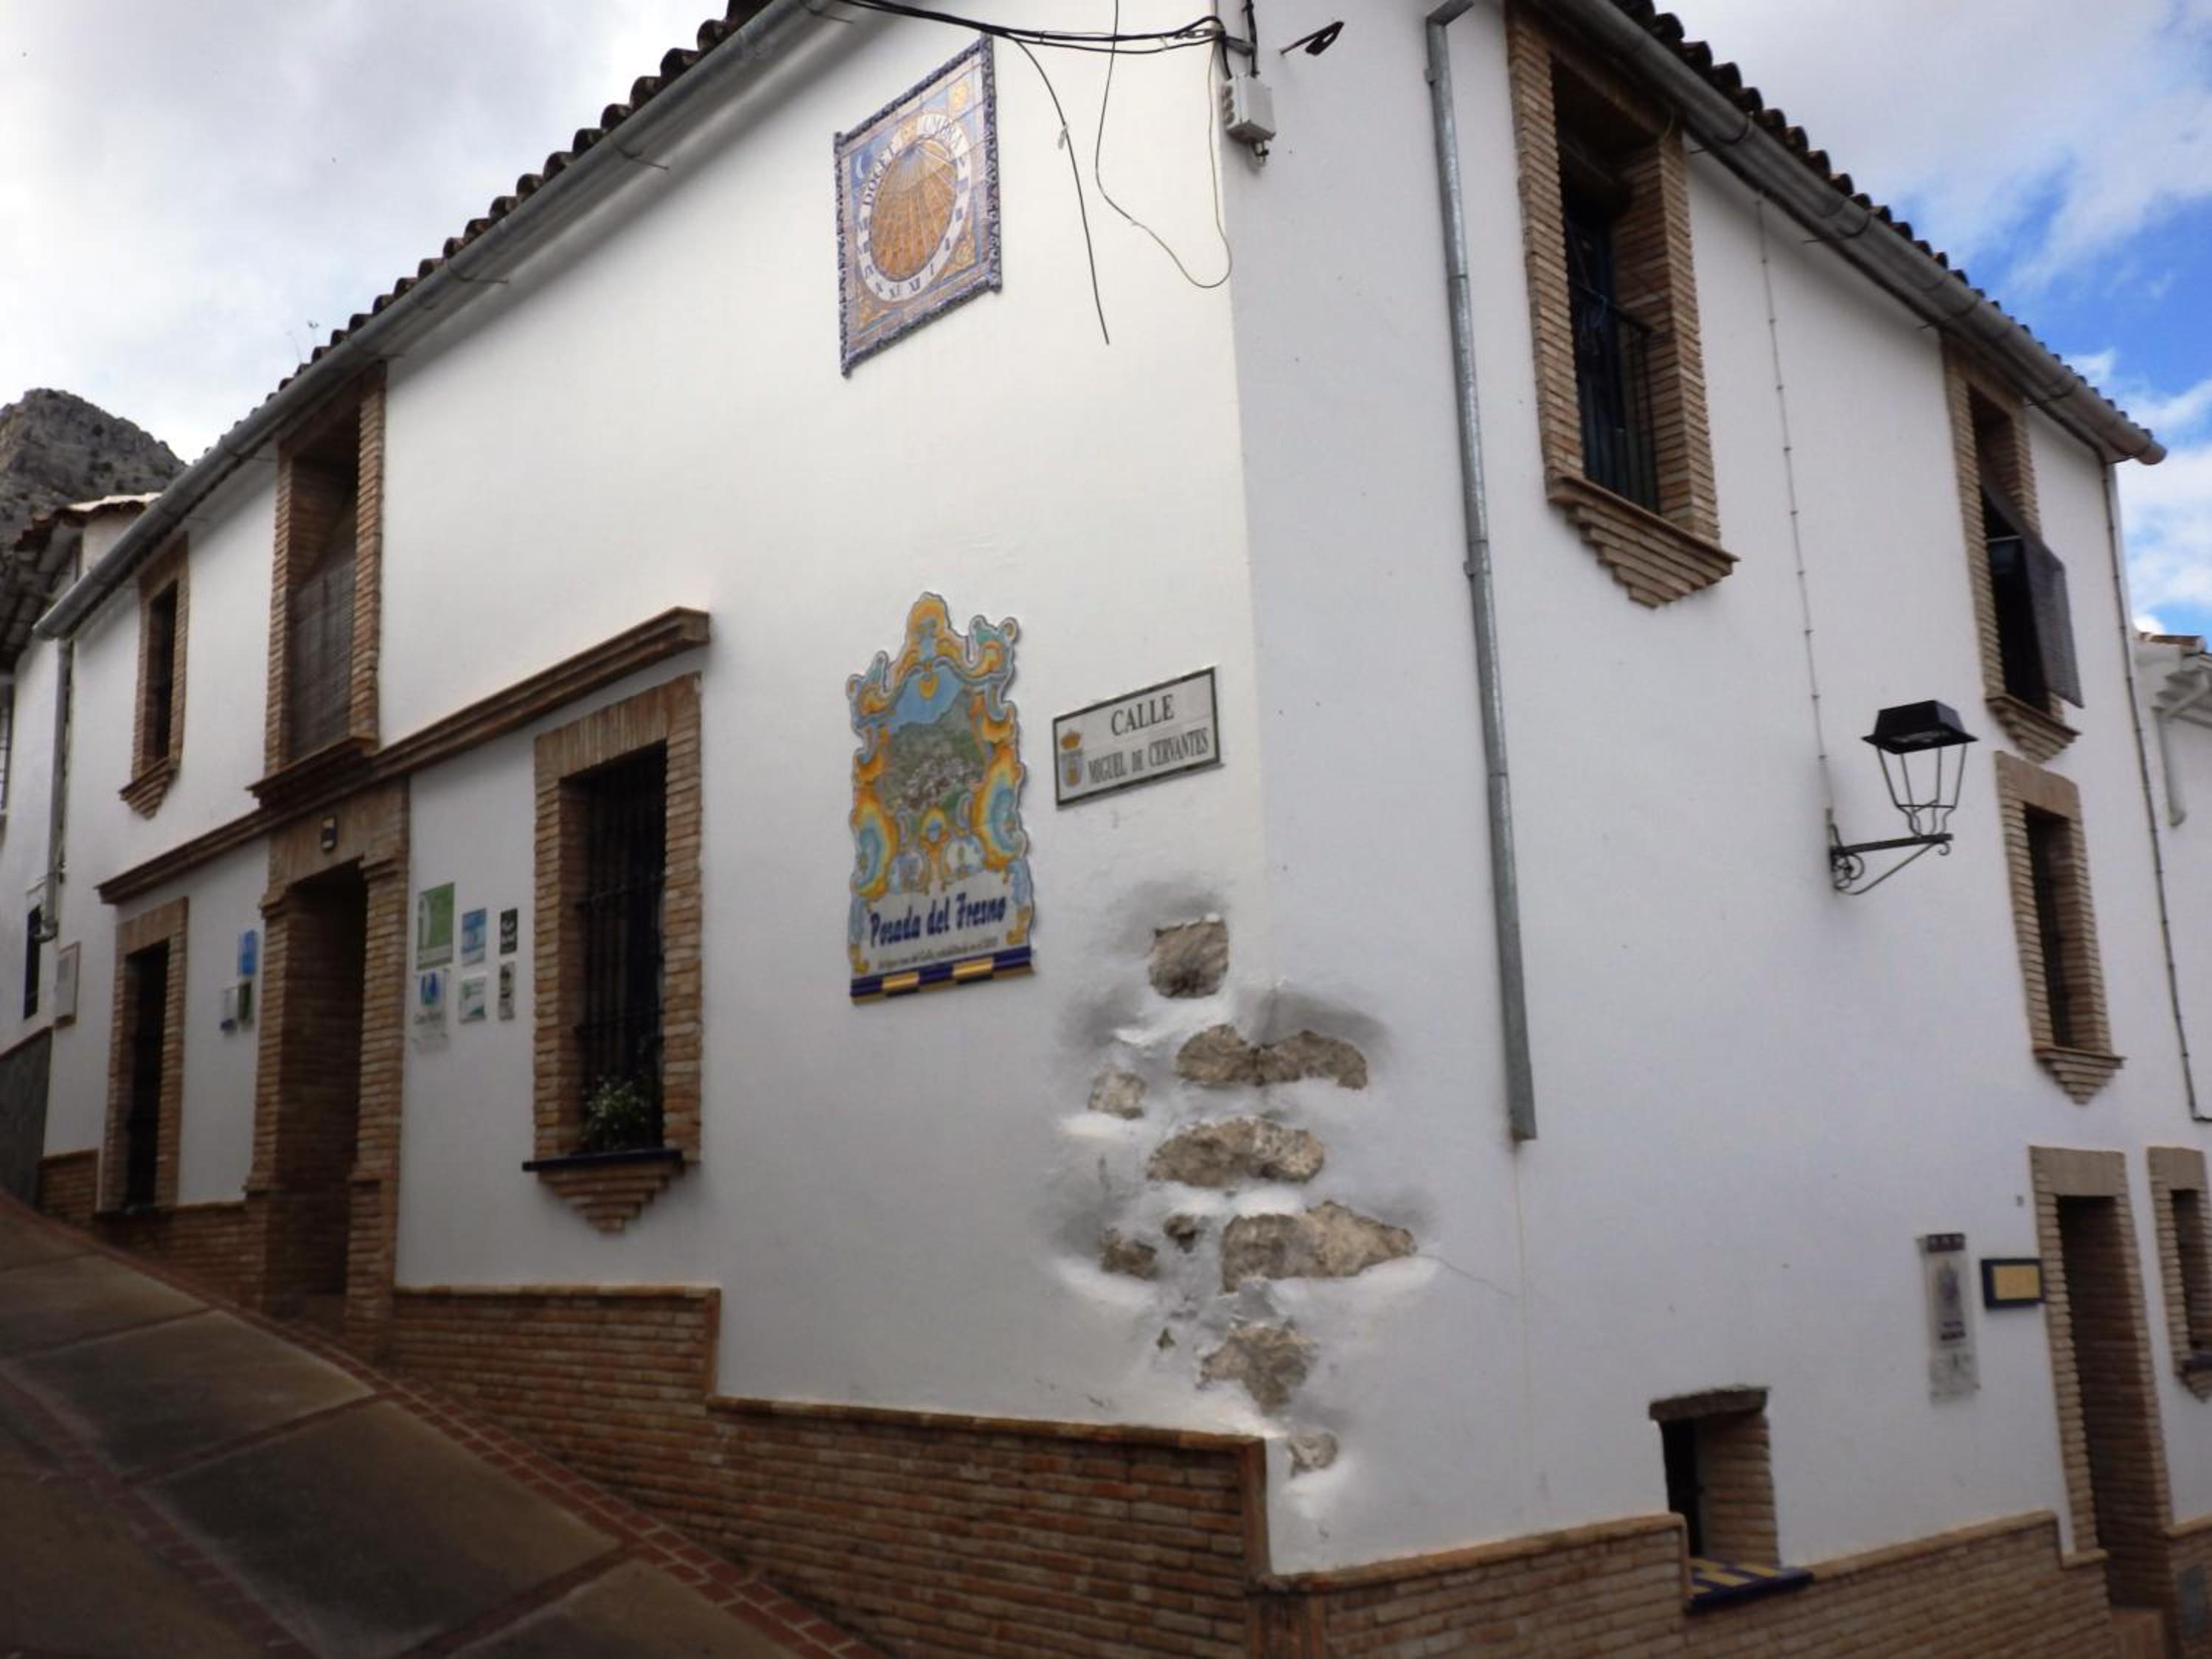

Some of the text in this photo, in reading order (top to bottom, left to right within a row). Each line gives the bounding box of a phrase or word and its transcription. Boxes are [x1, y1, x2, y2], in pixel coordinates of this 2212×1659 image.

[1110, 694, 1174, 736] CALLE
[1088, 751, 1127, 785] MIGUEL
[1147, 727, 1209, 768] CERVANTES
[871, 891, 1006, 947] Posada del Fresno
